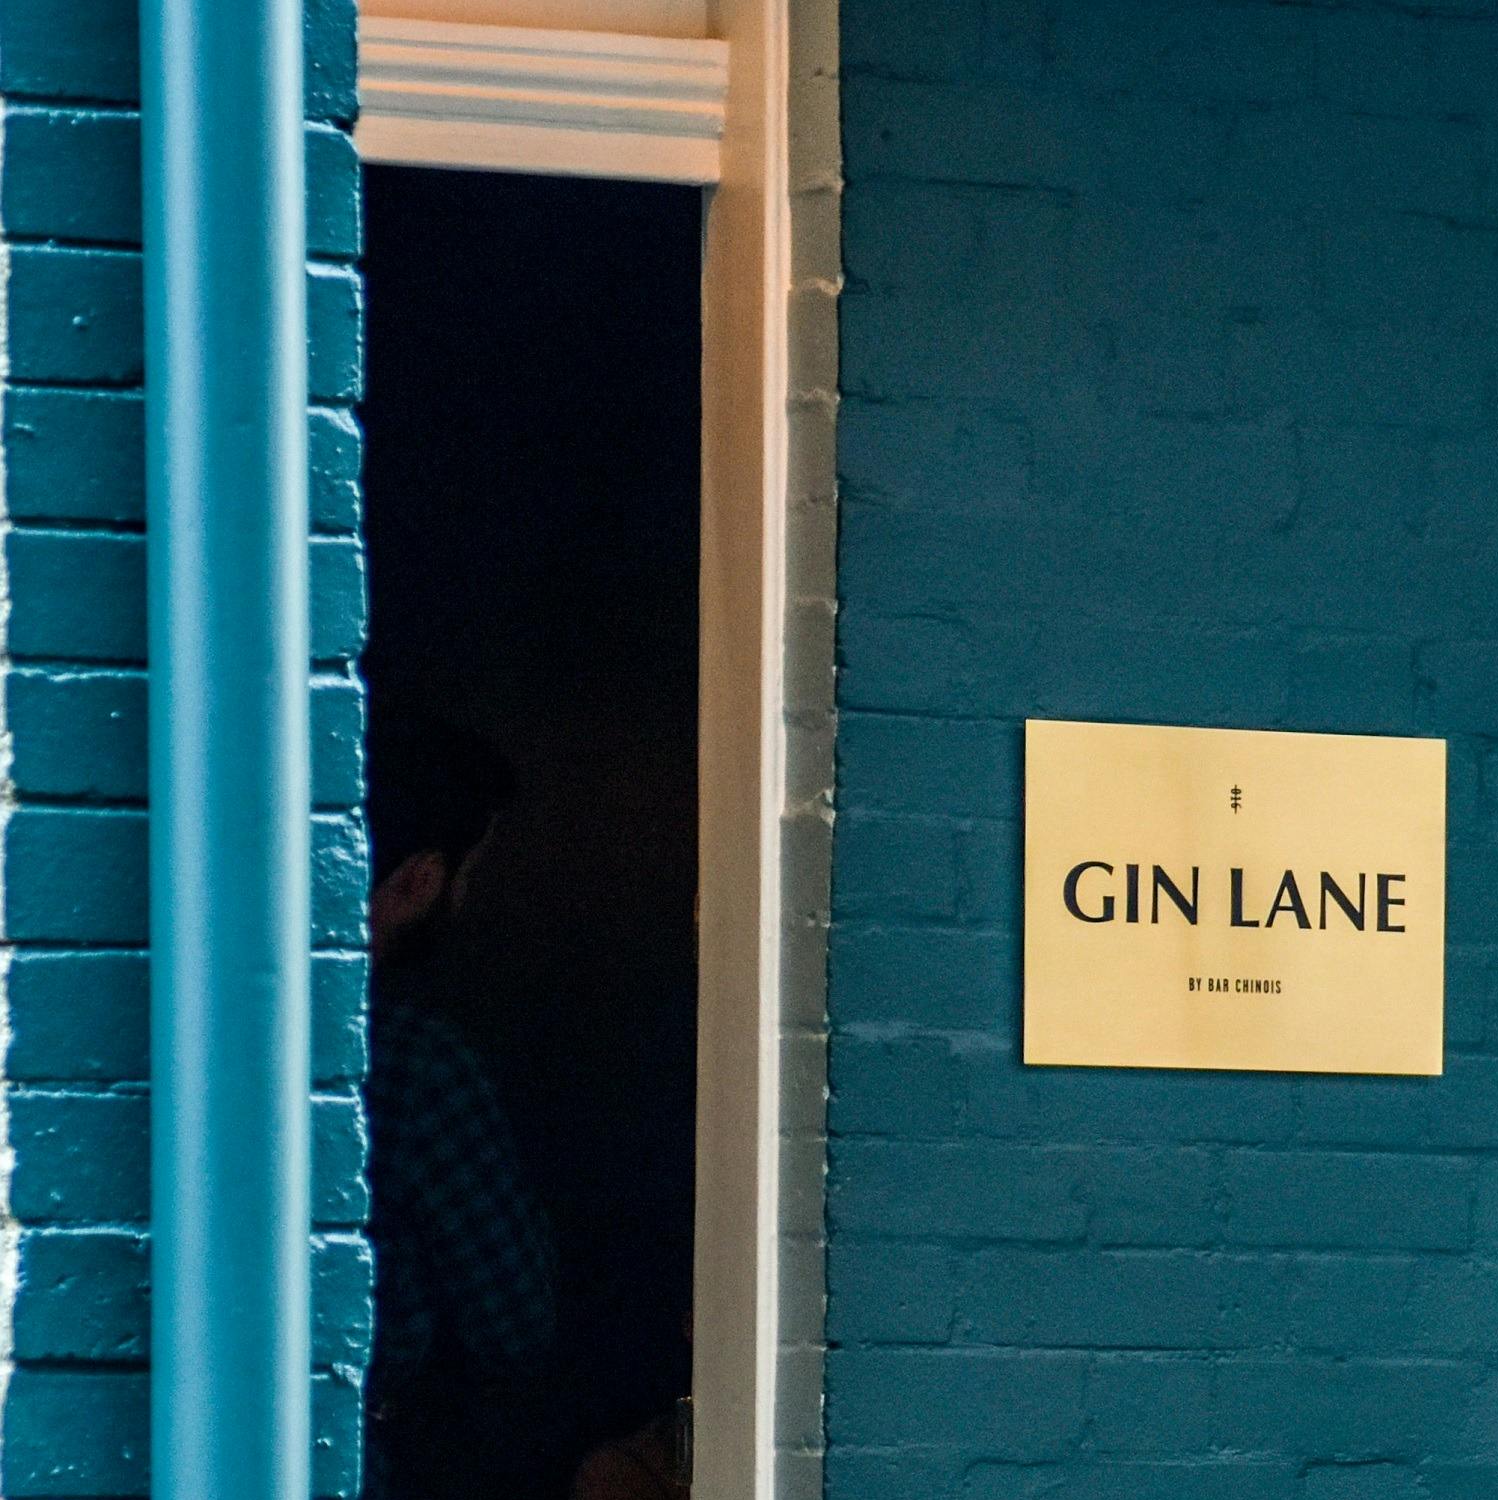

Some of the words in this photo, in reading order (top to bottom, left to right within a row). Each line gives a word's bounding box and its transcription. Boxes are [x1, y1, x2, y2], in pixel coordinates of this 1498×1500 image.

[1063, 861, 1199, 925] GIN
[1230, 868, 1406, 933] LANE
[1189, 977, 1201, 991] BY
[1208, 978, 1229, 992] BAR
[1235, 979, 1281, 994] CHINOIS
